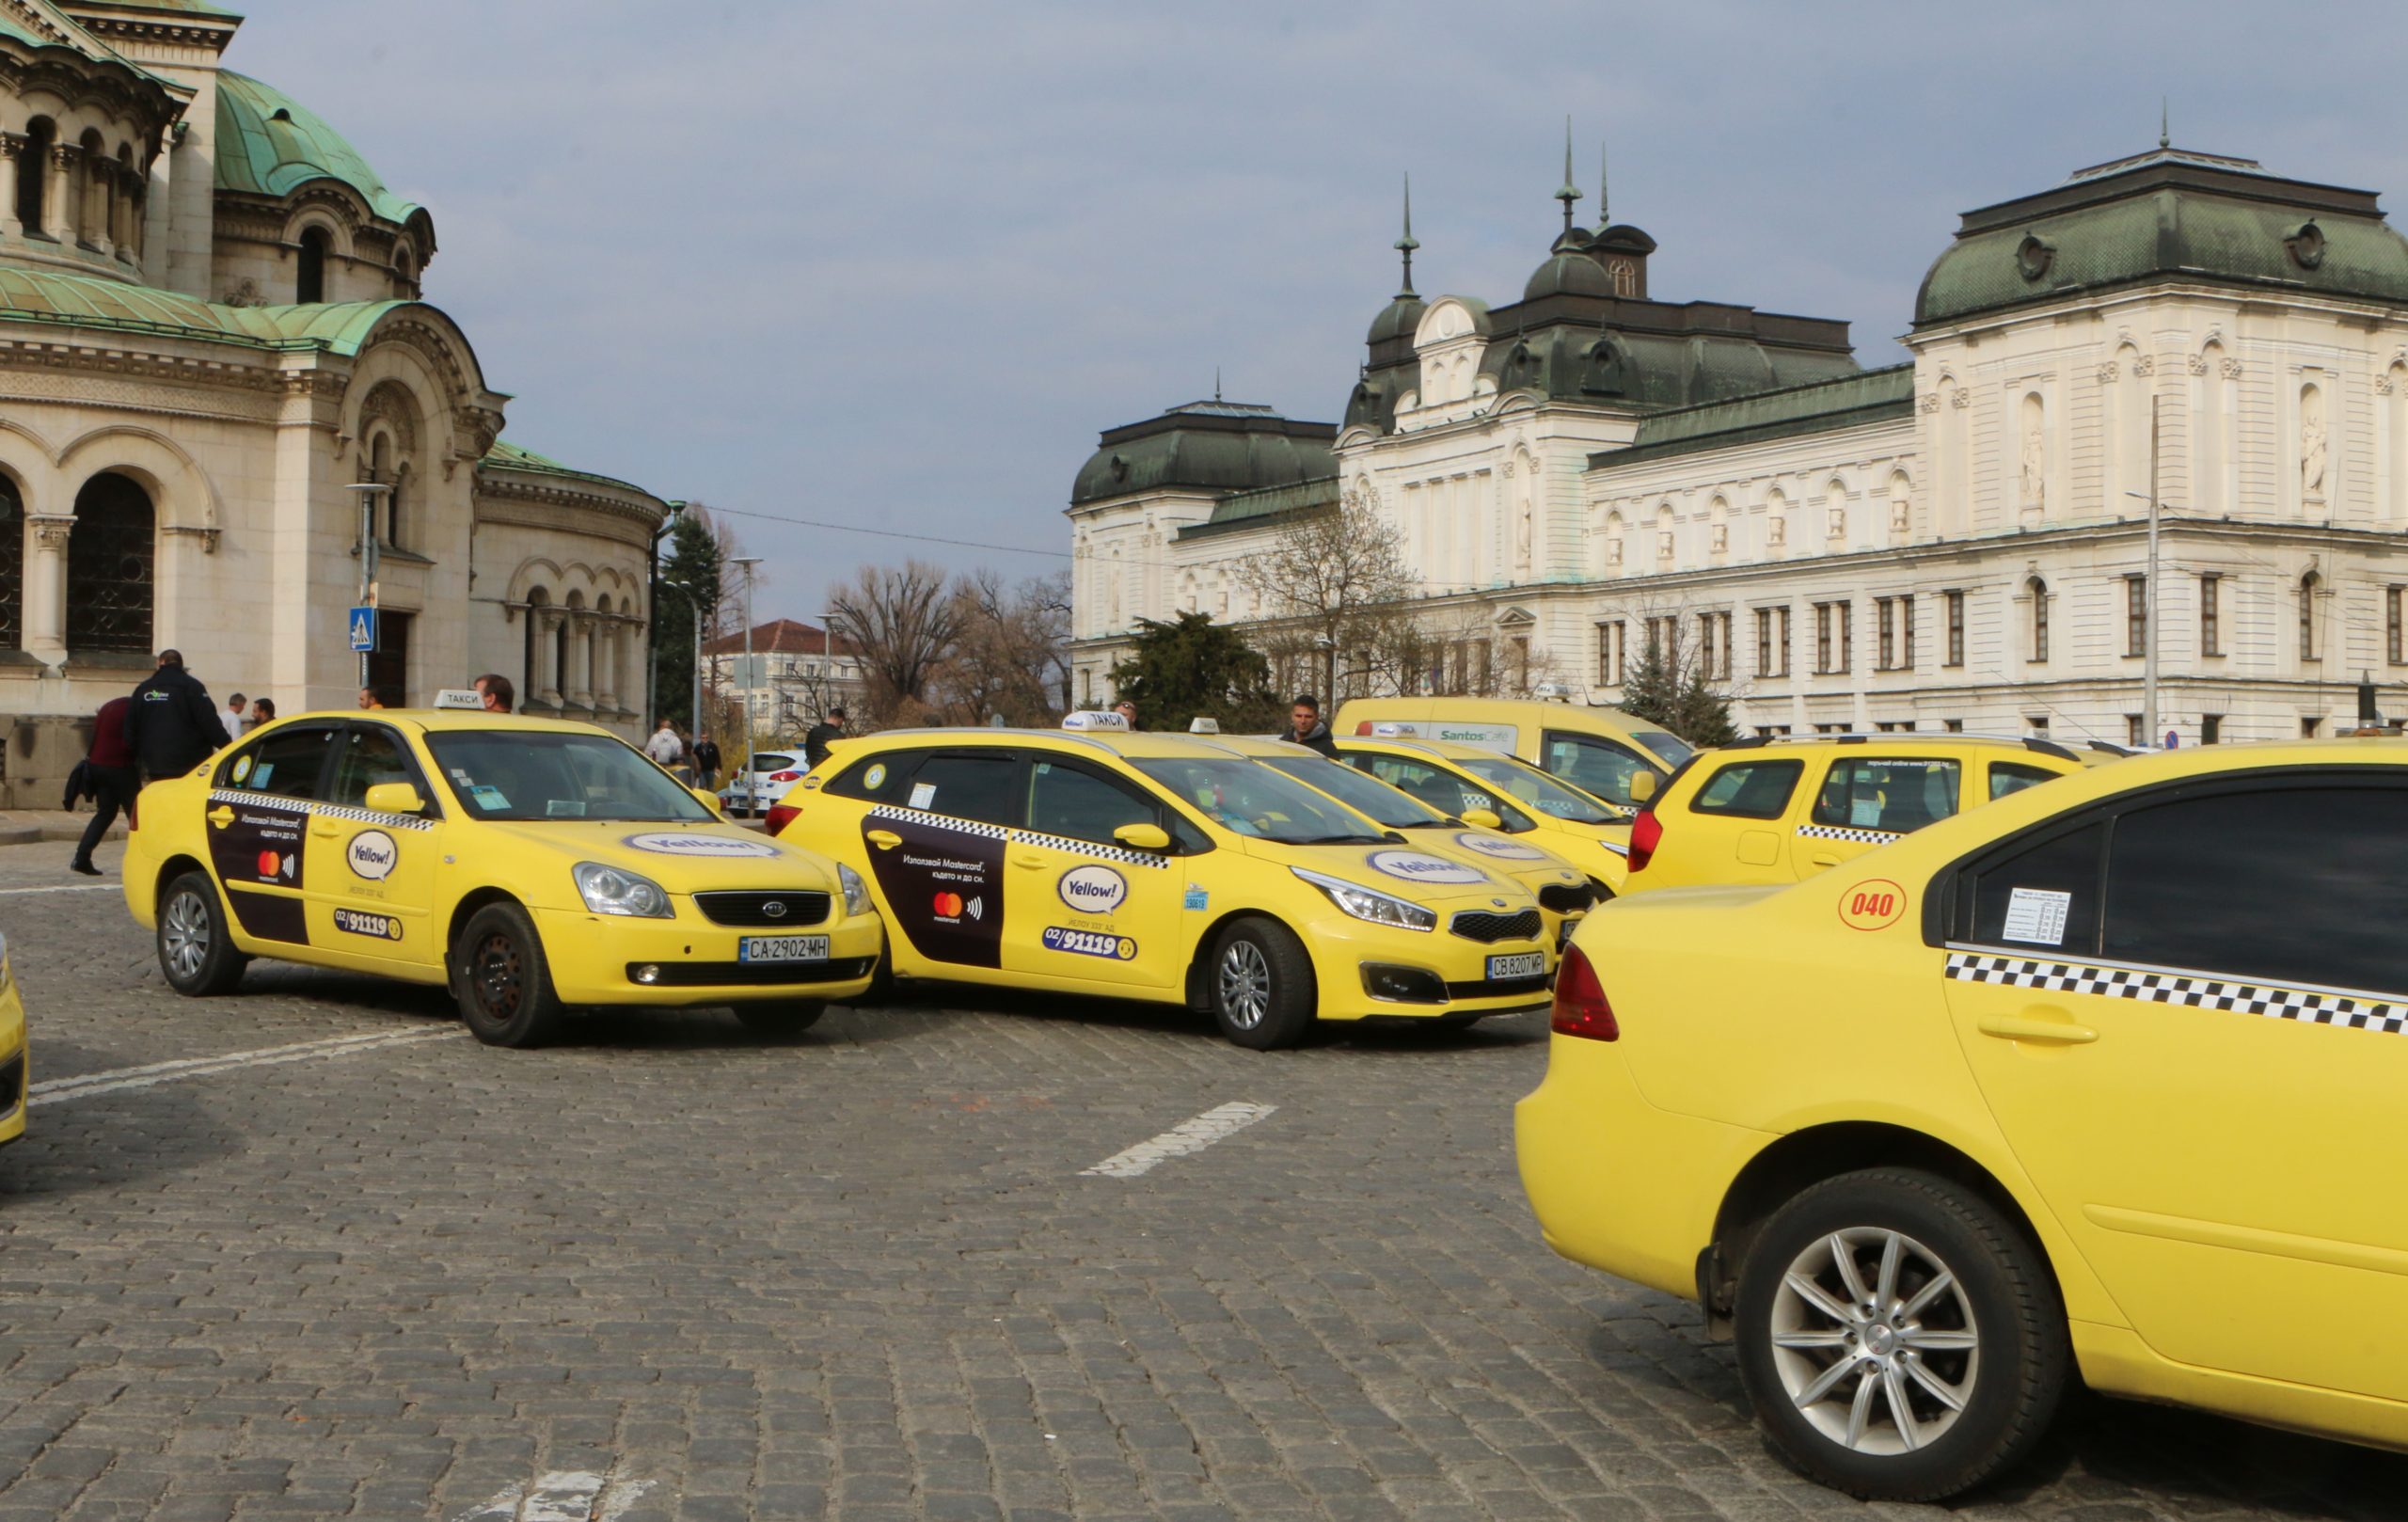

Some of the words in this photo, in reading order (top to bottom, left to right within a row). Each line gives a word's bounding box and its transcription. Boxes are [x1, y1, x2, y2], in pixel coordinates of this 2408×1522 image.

[447, 693, 479, 705] ТАКСИ
[1090, 713, 1124, 727] ТАКСИ
[648, 839, 757, 850] Yellow!
[354, 845, 391, 865] Yellow!
[903, 854, 942, 867] Използвай
[932, 871, 957, 880] където
[962, 874, 973, 883] до
[1069, 880, 1118, 898] Yellow!
[1851, 892, 1894, 917] 040
[750, 941, 769, 959] CA
[771, 940, 806, 958] 2902
[1509, 955, 1530, 975] 8207
